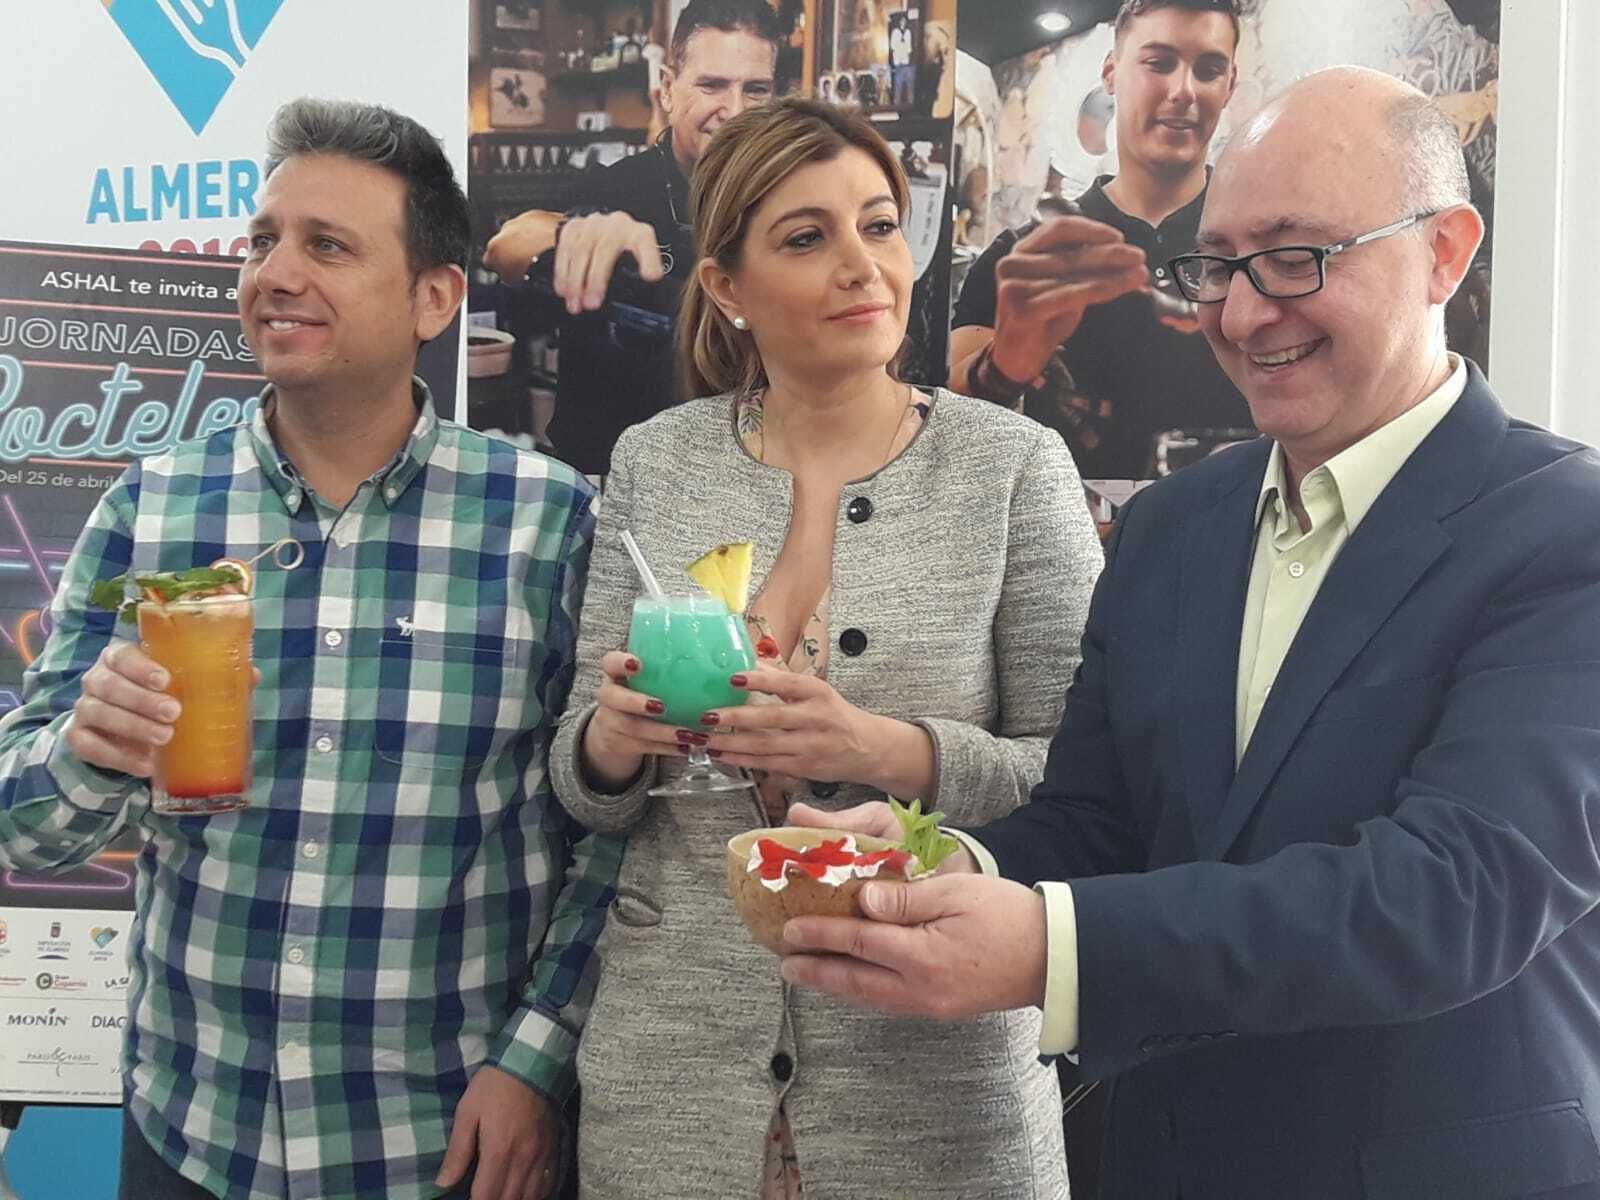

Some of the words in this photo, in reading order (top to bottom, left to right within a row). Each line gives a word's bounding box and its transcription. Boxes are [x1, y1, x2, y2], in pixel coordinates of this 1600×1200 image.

[41, 271, 123, 293] ASHAL
[128, 279, 152, 295] te
[159, 279, 219, 299] invita
[0, 316, 256, 362] JORNADAS
[26, 471, 48, 486] 25
[51, 473, 74, 487] de
